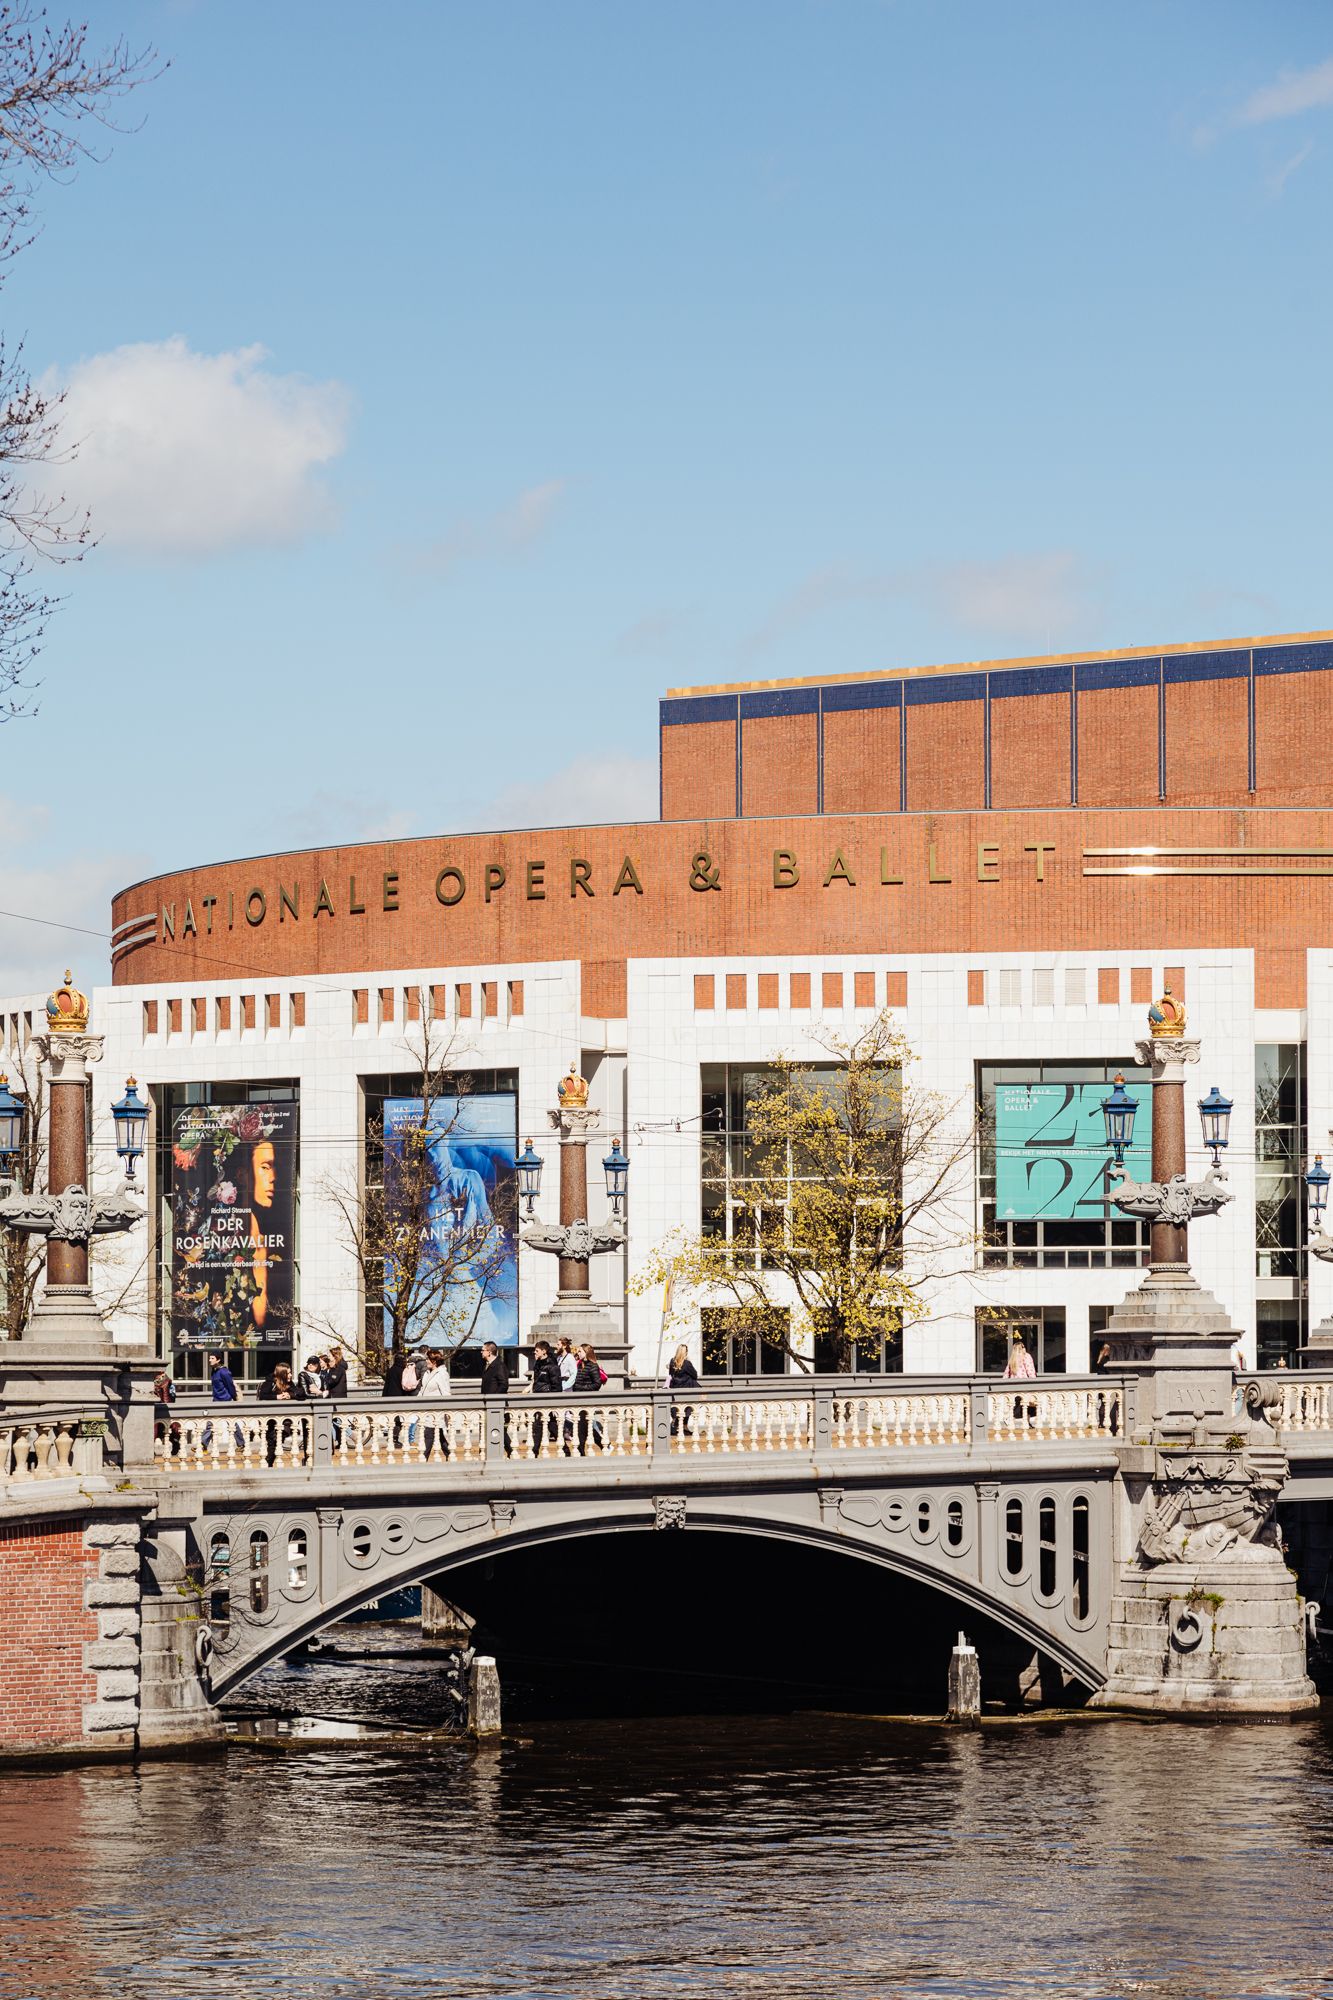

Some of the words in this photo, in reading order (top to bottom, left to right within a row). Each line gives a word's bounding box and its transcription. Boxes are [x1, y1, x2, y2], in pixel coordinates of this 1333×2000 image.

[162, 871, 399, 943] NATIONALE
[435, 856, 643, 906] OPERA
[689, 852, 722, 892] &
[773, 842, 1056, 889] BALLET
[1025, 1157, 1116, 1218] 24
[232, 1206, 252, 1214] Strauss
[217, 1218, 244, 1232] DER
[395, 1225, 506, 1242] ZANENMEER
[176, 1234, 285, 1250] ROSENKAVALIER
